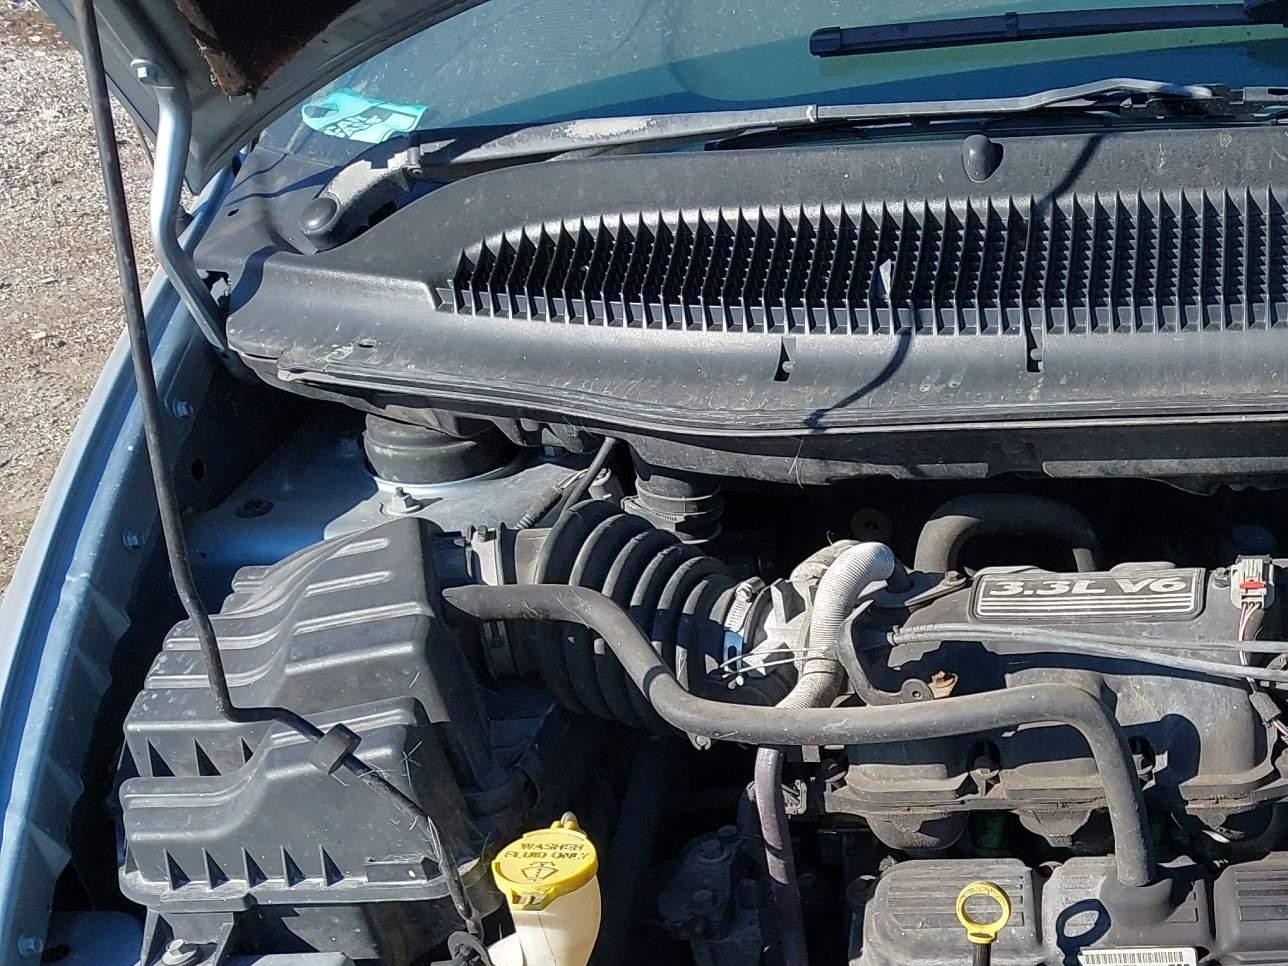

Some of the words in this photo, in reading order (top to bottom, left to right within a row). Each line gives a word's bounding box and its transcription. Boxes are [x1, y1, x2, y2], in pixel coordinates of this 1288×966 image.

[989, 579, 1107, 597] 3.3L
[1115, 576, 1187, 595] V6
[504, 850, 548, 859] FLUID
[551, 851, 590, 860] ONLY
